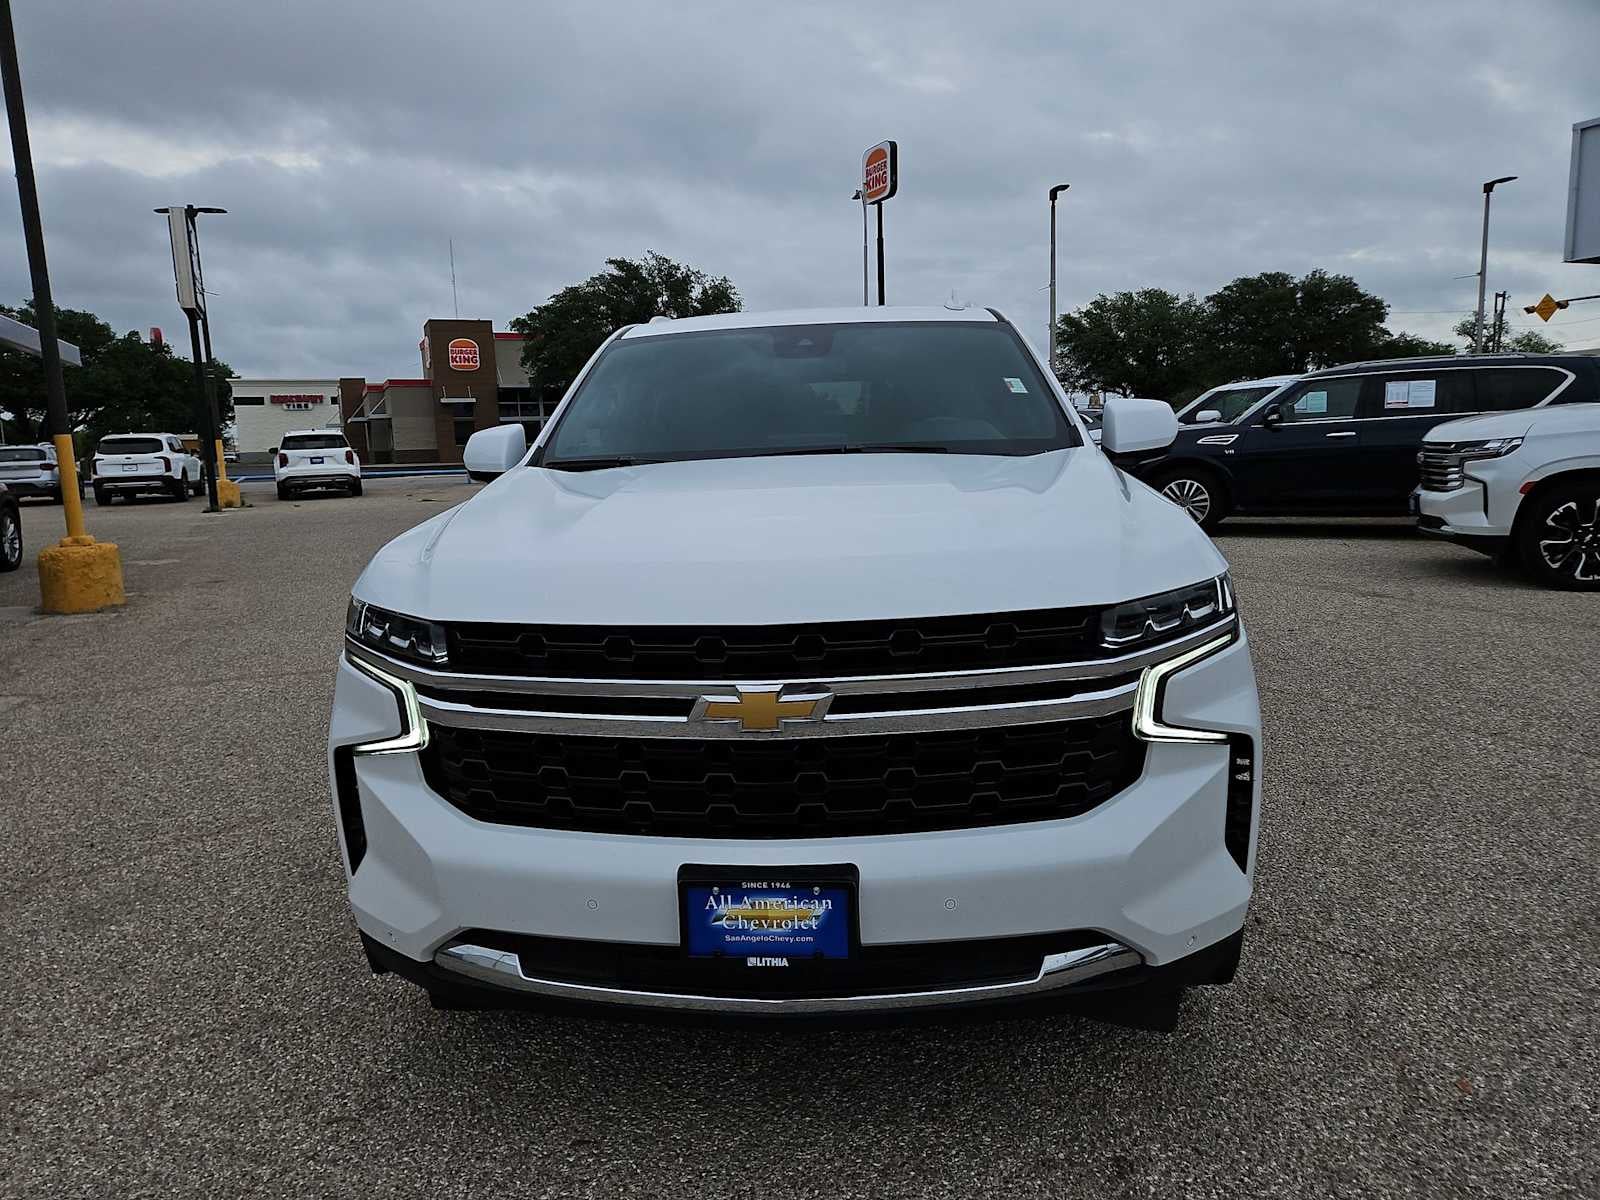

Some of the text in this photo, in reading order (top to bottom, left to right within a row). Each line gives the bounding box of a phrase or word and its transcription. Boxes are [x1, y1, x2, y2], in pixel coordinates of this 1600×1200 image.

[866, 160, 887, 178] BURGER
[866, 171, 887, 192] KING
[451, 355, 478, 364] KING
[704, 895, 833, 910] All American
[723, 914, 818, 930] Chevrolet
[725, 935, 814, 943] SanAngeloChevy.com
[756, 957, 789, 967] LITHIA
